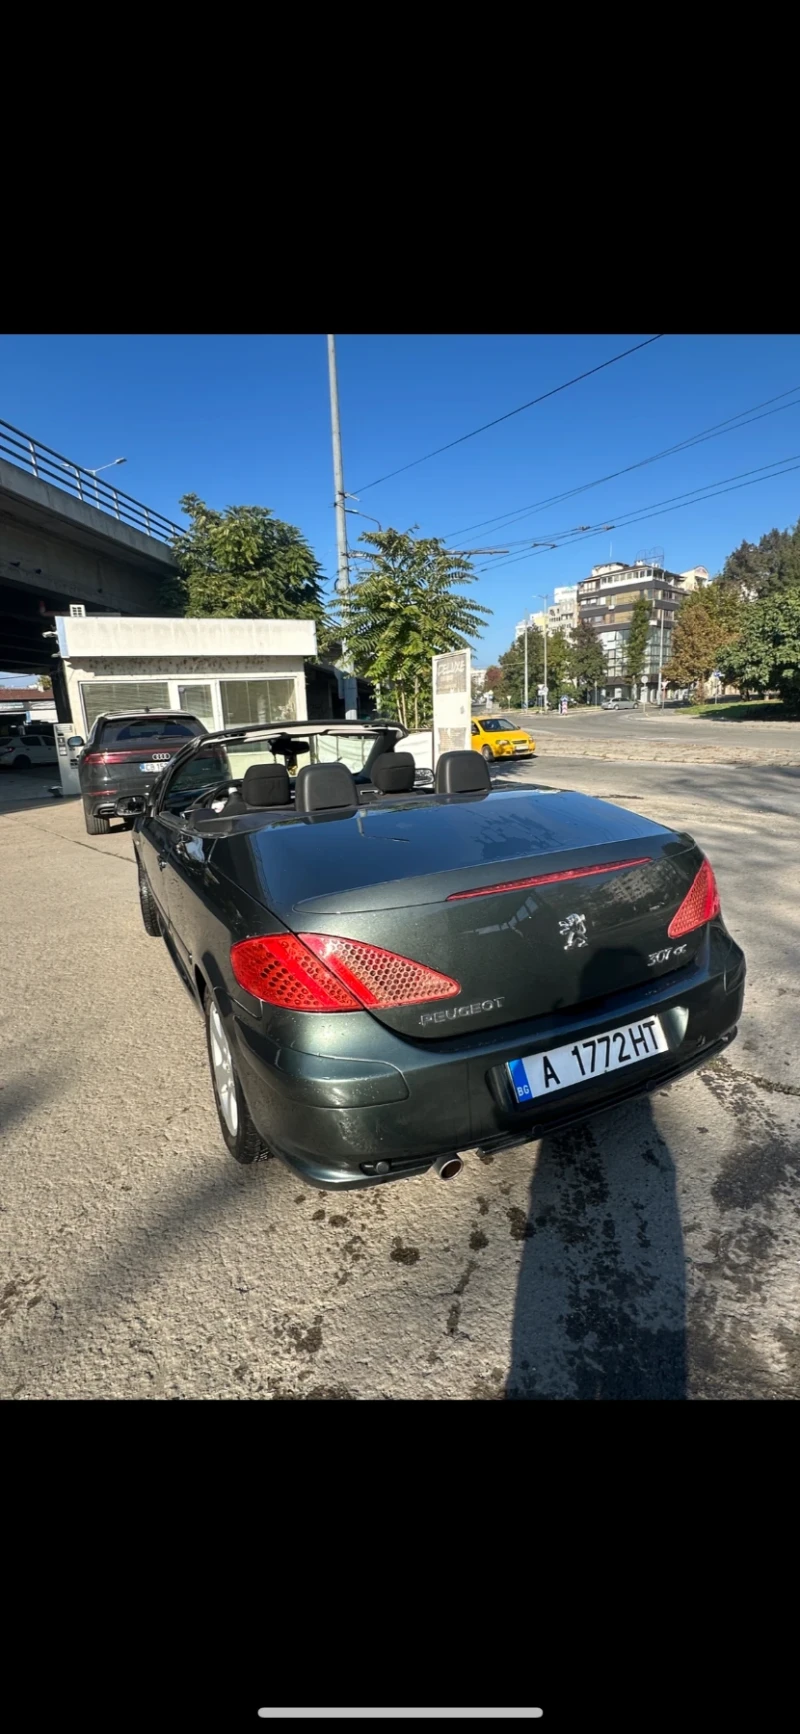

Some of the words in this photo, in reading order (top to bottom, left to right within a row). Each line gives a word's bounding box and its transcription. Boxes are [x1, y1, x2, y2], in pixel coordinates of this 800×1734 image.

[647, 946, 673, 966] 307
[418, 997, 505, 1026] PEUGEOT
[542, 1056, 560, 1088] A
[516, 1085, 530, 1096] BG
